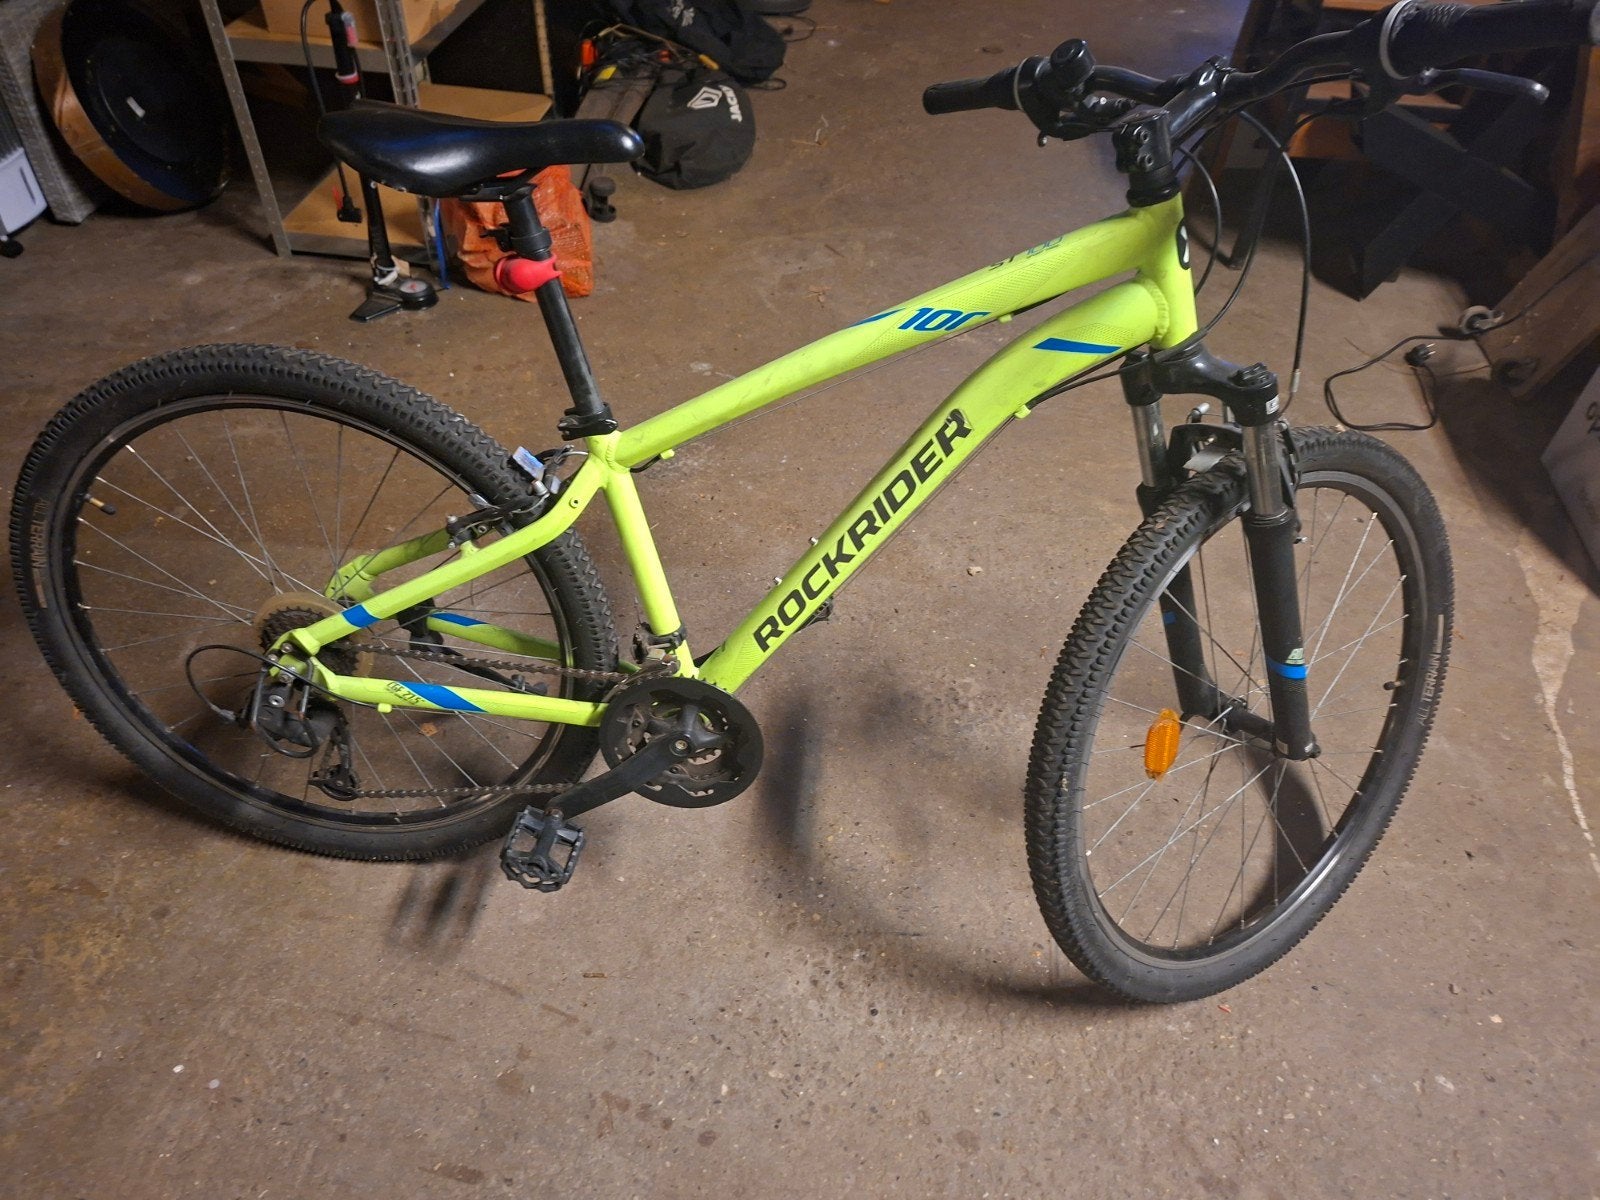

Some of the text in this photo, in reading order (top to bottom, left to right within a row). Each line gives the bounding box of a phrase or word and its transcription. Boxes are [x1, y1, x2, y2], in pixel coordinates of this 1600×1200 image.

[30, 519, 48, 569] TERRAIN
[753, 408, 972, 653] ROCKRIDER
[1421, 653, 1441, 702] TERRAIN
